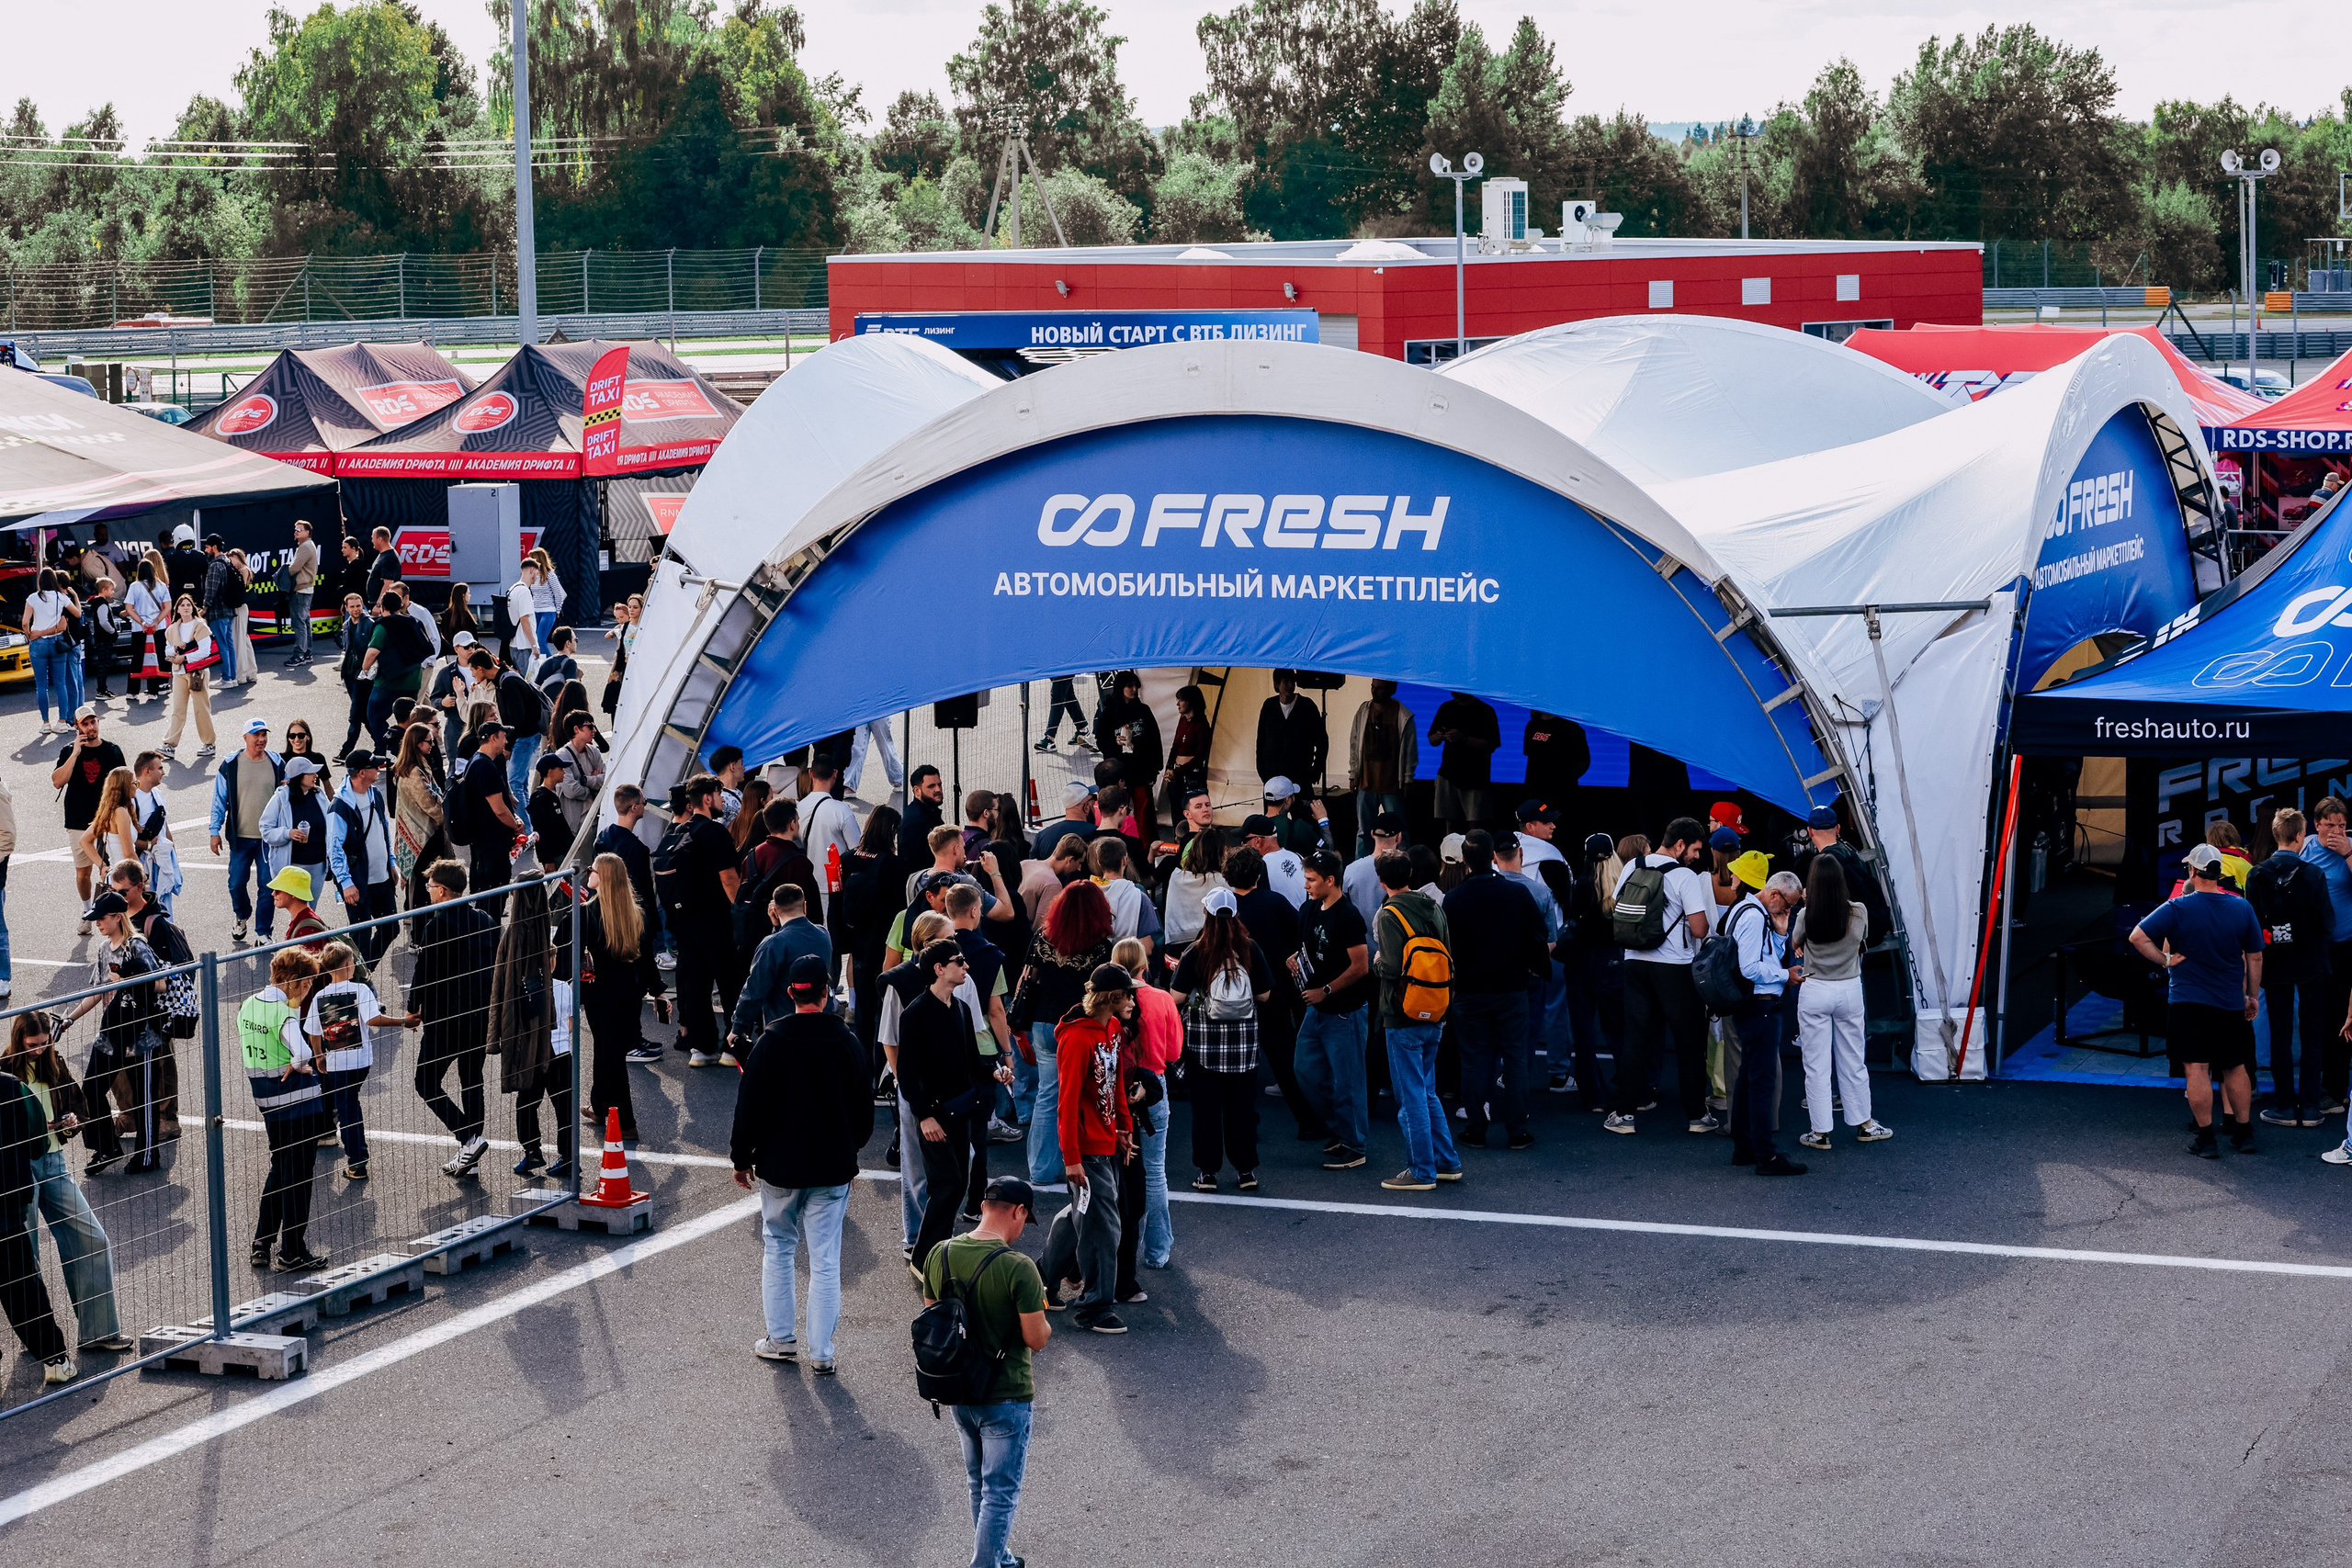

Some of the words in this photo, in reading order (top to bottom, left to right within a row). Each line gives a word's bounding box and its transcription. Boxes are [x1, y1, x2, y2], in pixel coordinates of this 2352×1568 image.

[1031, 321, 1102, 344] НОВЫЙ
[1108, 325, 1167, 344] СТАРТ
[1172, 325, 1185, 342] С
[1190, 324, 1225, 340] ВТБ
[1228, 324, 1307, 341] ЛИЗИНГ
[590, 375, 621, 392] DRIFT
[369, 394, 417, 415] RDS
[590, 387, 620, 406] TAXI
[228, 408, 267, 420] RDS
[466, 406, 507, 417] RDS
[587, 429, 616, 446] DRIFT
[587, 440, 616, 459] TAXI
[491, 489, 496, 497] 2
[2035, 546, 2096, 592] АВТОМОБИЛЬНЫЙ
[2097, 534, 2144, 571] МАРКЕТПЛЕЙС
[993, 569, 1263, 599] АВТОМОБИЛЬНЫЙ
[1271, 571, 1500, 604] МАРКЕТПЛЕЙС
[2095, 716, 2250, 739] freshauto.ru
